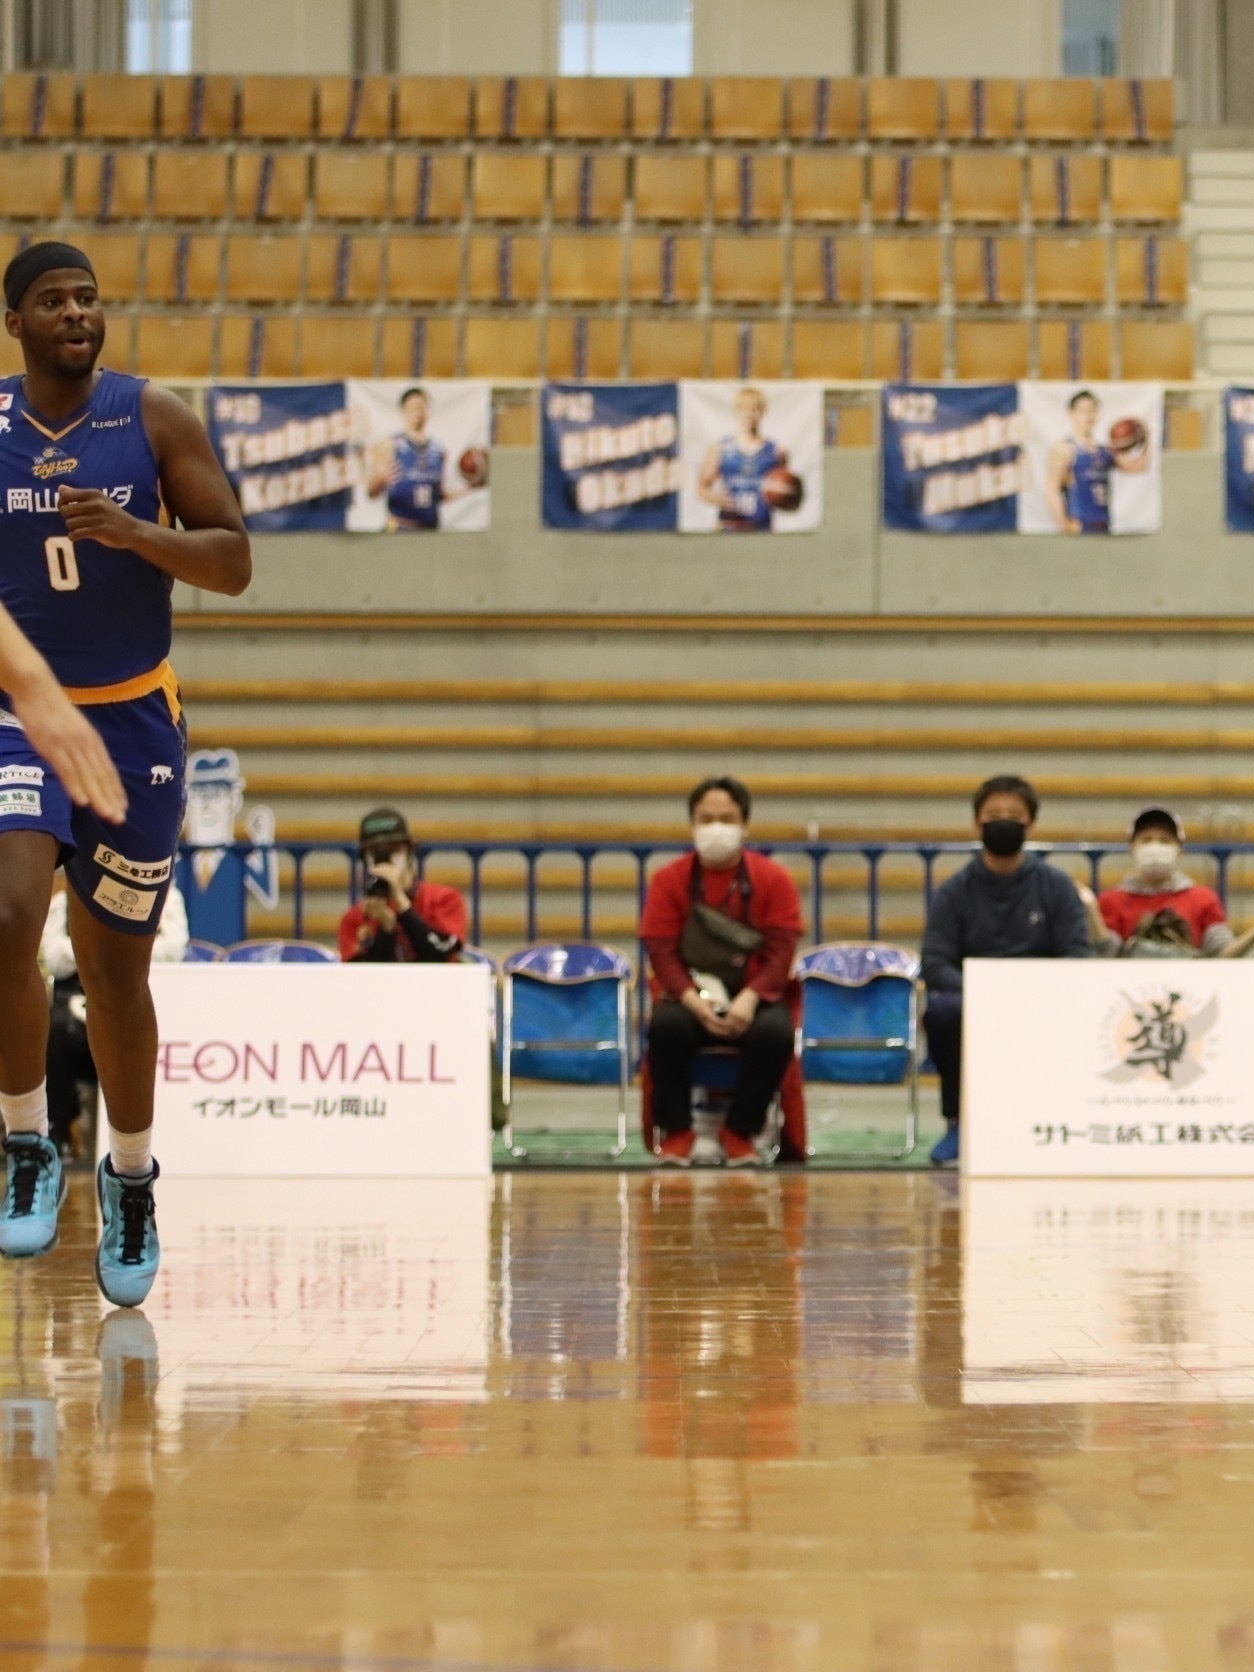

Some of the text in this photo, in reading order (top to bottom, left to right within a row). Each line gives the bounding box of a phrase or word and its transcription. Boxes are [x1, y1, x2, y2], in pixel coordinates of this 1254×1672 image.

[7, 484, 134, 513] 岡山ダ
[44, 536, 81, 592] 0
[299, 1041, 456, 1082] MALL
[192, 1096, 387, 1119] イオンモール岡山
